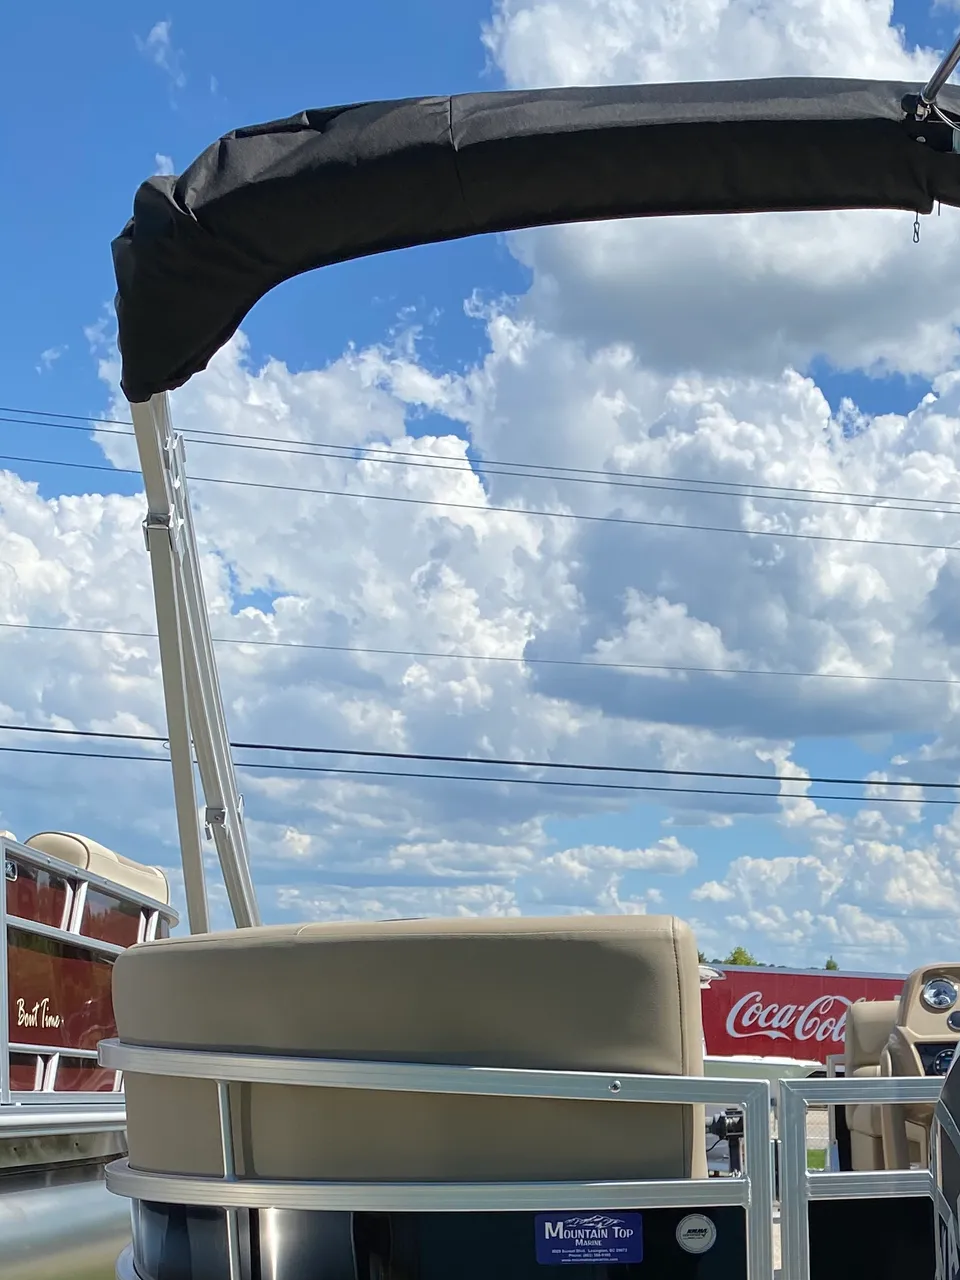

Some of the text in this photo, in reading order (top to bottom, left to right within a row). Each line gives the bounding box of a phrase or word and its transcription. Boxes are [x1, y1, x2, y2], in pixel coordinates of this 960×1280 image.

[725, 991, 866, 1042] Coca-Col
[544, 1221, 634, 1240] MOUNTAIN TOP
[575, 1239, 602, 1247] MARINE
